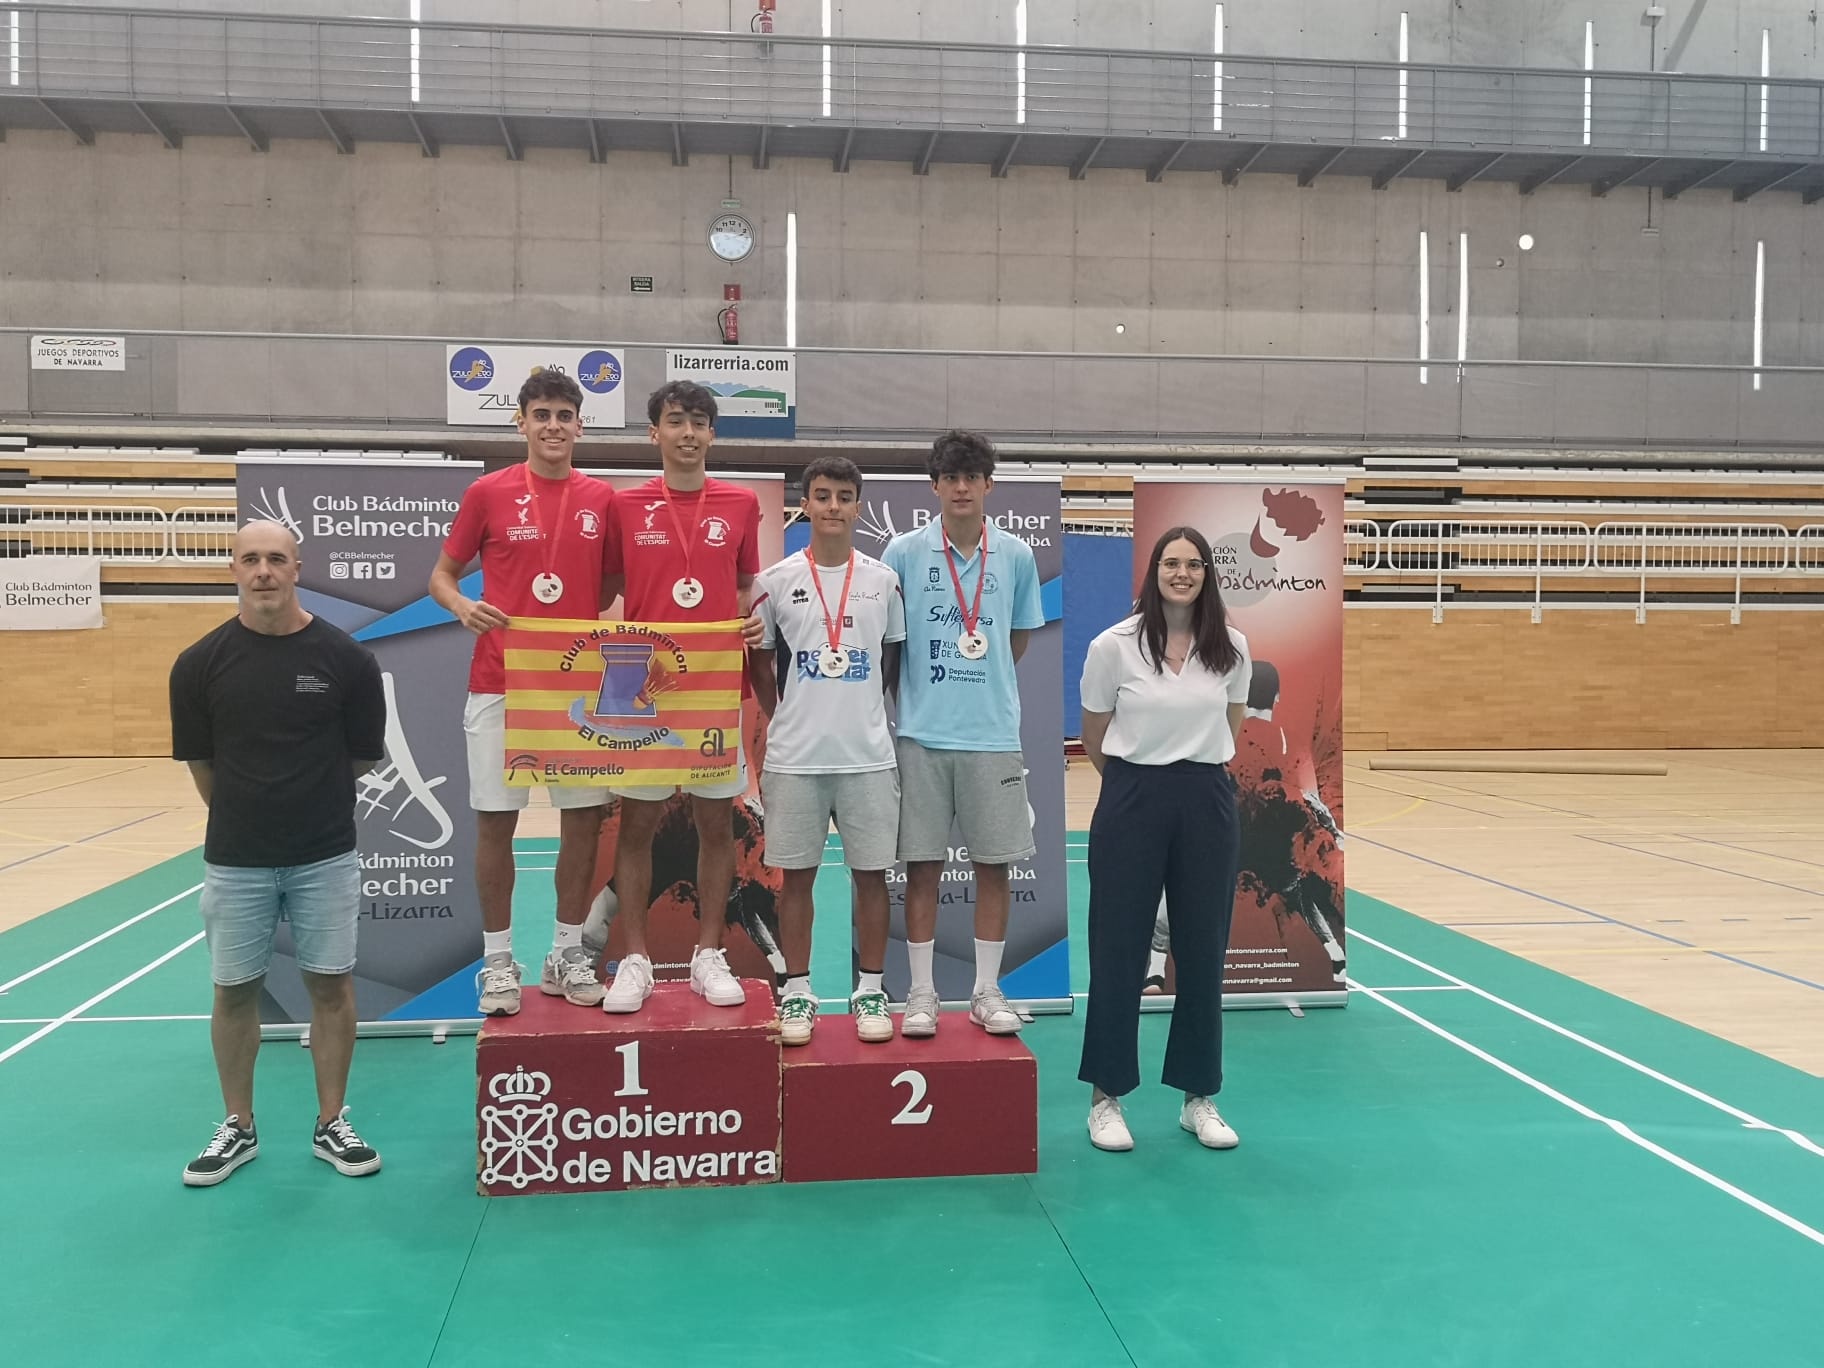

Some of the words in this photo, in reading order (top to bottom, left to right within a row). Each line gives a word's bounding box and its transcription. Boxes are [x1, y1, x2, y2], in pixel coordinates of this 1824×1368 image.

[38, 348, 67, 356] JUEGOS
[72, 349, 119, 357] DEPORTIVOS
[674, 354, 788, 371] lizarrerria.com
[313, 495, 358, 511] Club
[363, 496, 460, 512] Bádminto
[313, 514, 453, 537] Belmeche
[329, 551, 395, 560] @CBBelmecher
[5, 582, 30, 591] Club
[32, 582, 92, 591] Bádminton
[6, 593, 92, 605] Belmecher
[560, 638, 587, 673] Club
[590, 627, 609, 641] de
[616, 624, 688, 674] Bádminton
[577, 725, 593, 741] El
[597, 726, 670, 751] Campello
[544, 763, 558, 776] El
[560, 763, 625, 779] Campello
[614, 1040, 649, 1097] 1
[891, 1070, 933, 1124] 2
[562, 1104, 742, 1140] Gobierno
[562, 1151, 612, 1184] de
[623, 1149, 776, 1183] Navarra
